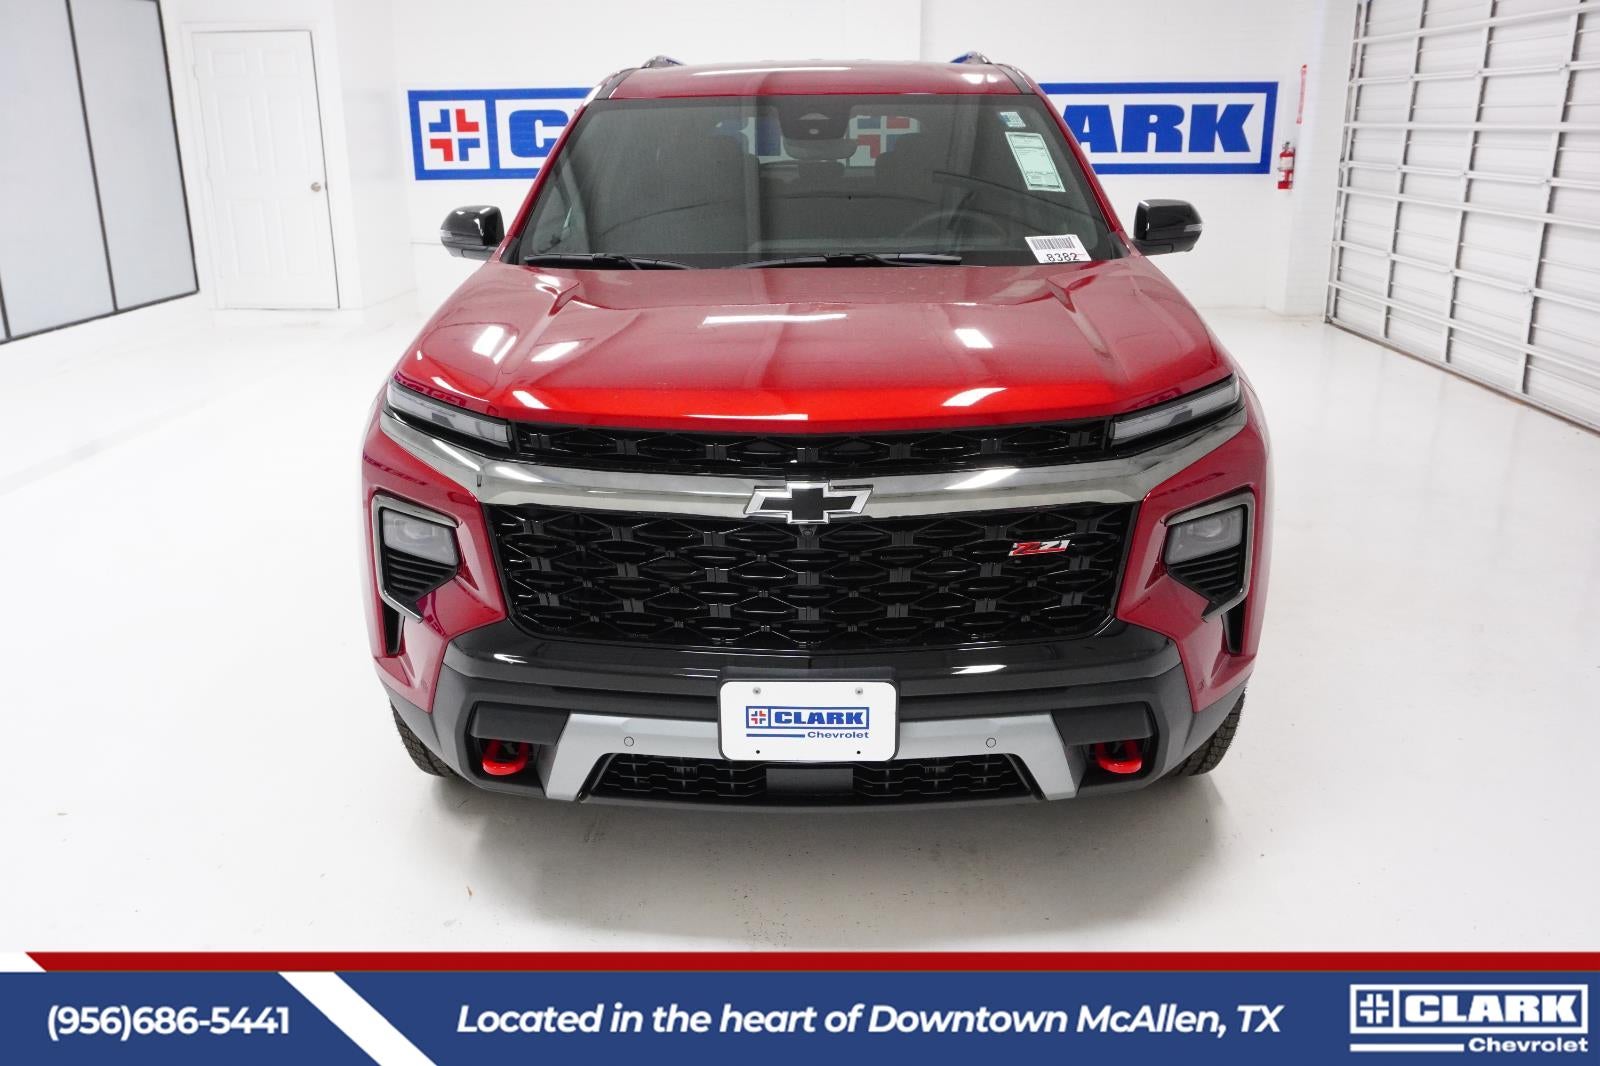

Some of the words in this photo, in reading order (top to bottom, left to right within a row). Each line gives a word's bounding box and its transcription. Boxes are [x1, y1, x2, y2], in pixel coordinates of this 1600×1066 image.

[1046, 252, 1080, 262] 8382
[774, 711, 864, 725] CLARK
[807, 731, 870, 739] Chevrolet
